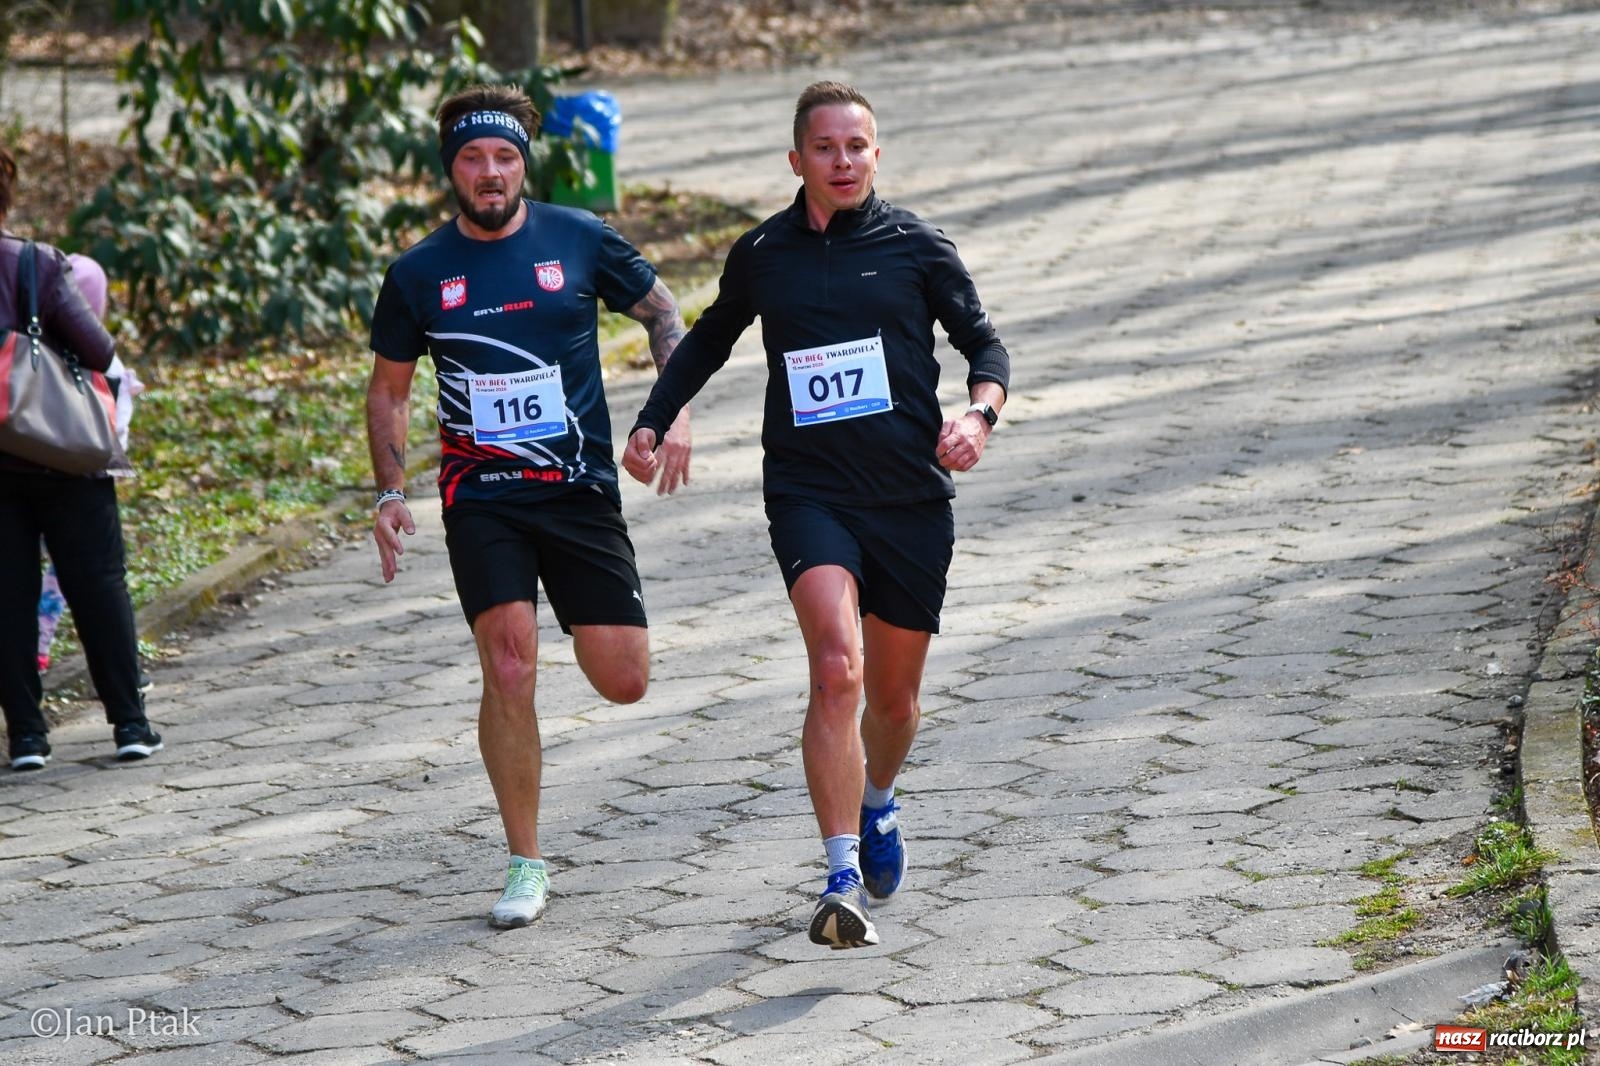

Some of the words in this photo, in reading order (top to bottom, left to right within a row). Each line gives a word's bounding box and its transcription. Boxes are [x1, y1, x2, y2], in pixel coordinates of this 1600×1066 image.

[440, 275, 466, 285] POLSKA
[791, 357, 803, 365] XIV
[805, 353, 823, 363] BIEG
[825, 344, 875, 359] TWARDZIELA
[488, 378, 507, 387] BIEG
[509, 372, 555, 385] TWARDZIELA
[808, 368, 864, 403] 017
[493, 394, 542, 424] 116
